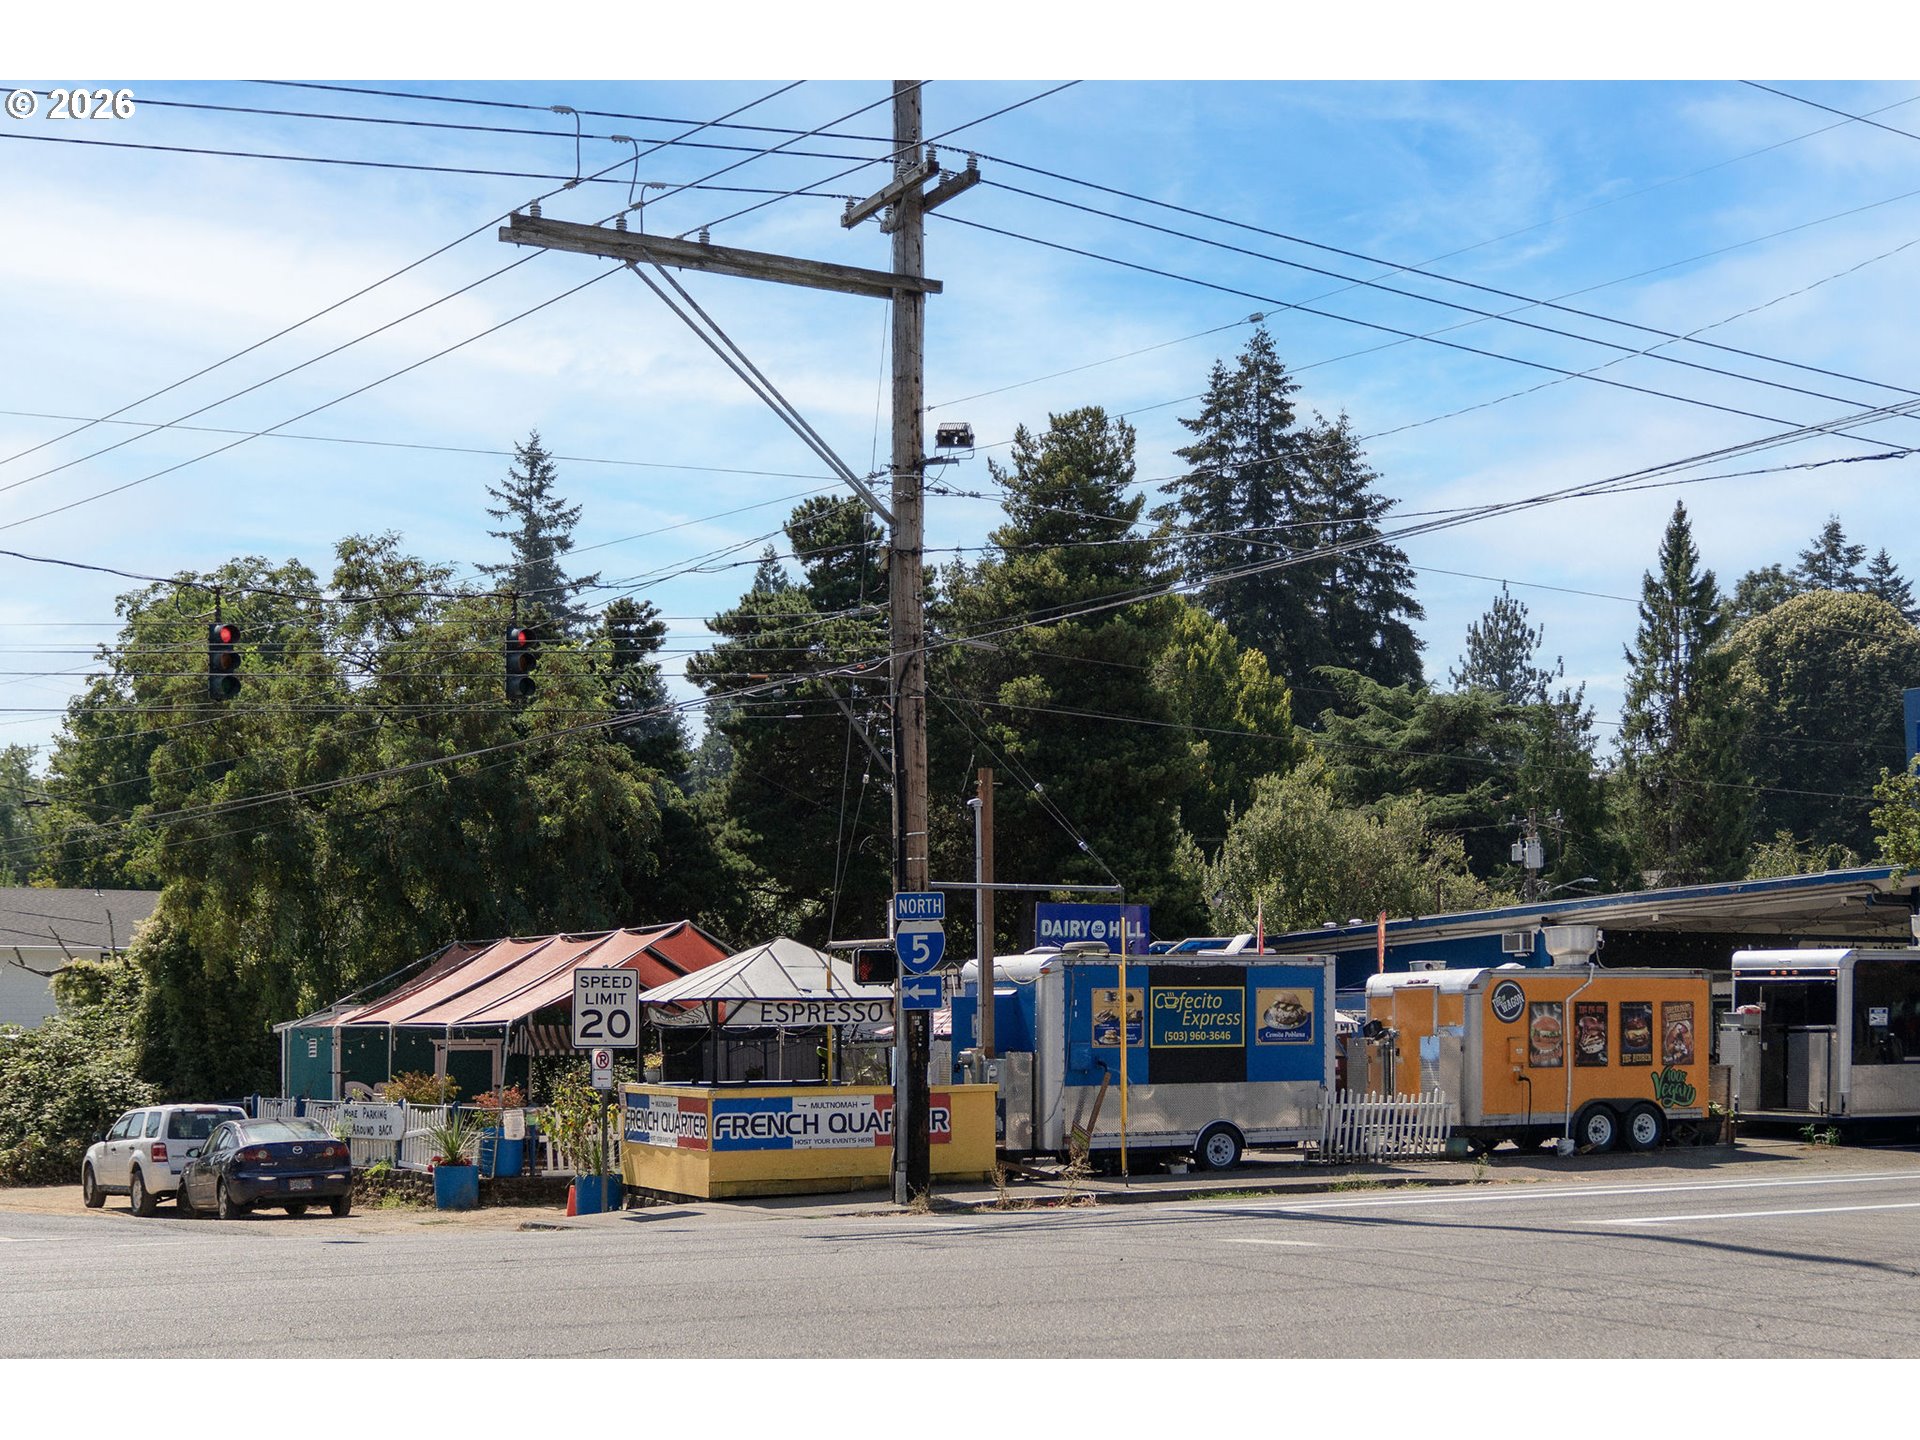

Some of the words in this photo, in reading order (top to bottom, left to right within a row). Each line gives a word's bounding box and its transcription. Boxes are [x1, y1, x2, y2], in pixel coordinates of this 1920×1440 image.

[899, 898, 942, 914] NORTH
[1041, 919, 1091, 938] DAIRY
[1109, 920, 1146, 939] HLL
[912, 934, 931, 964] 5
[580, 975, 633, 989] SPEED
[585, 992, 627, 1005] LIMIT
[760, 1002, 884, 1024] ESPRESSO
[1182, 1010, 1241, 1030] Express
[580, 1009, 631, 1039] 20
[1164, 1031, 1188, 1043] (503)
[1189, 1031, 1231, 1041] 960-3646
[1651, 1066, 1696, 1108] Vegan
[363, 1106, 387, 1120] PARKING
[810, 1101, 858, 1109] MULTNOMAH
[379, 1124, 393, 1136] BACK
[625, 1109, 659, 1132] FRENCH
[661, 1112, 708, 1138] QUARTER
[715, 1113, 819, 1138] FRENCH
[832, 1136, 857, 1144] EVENTS
